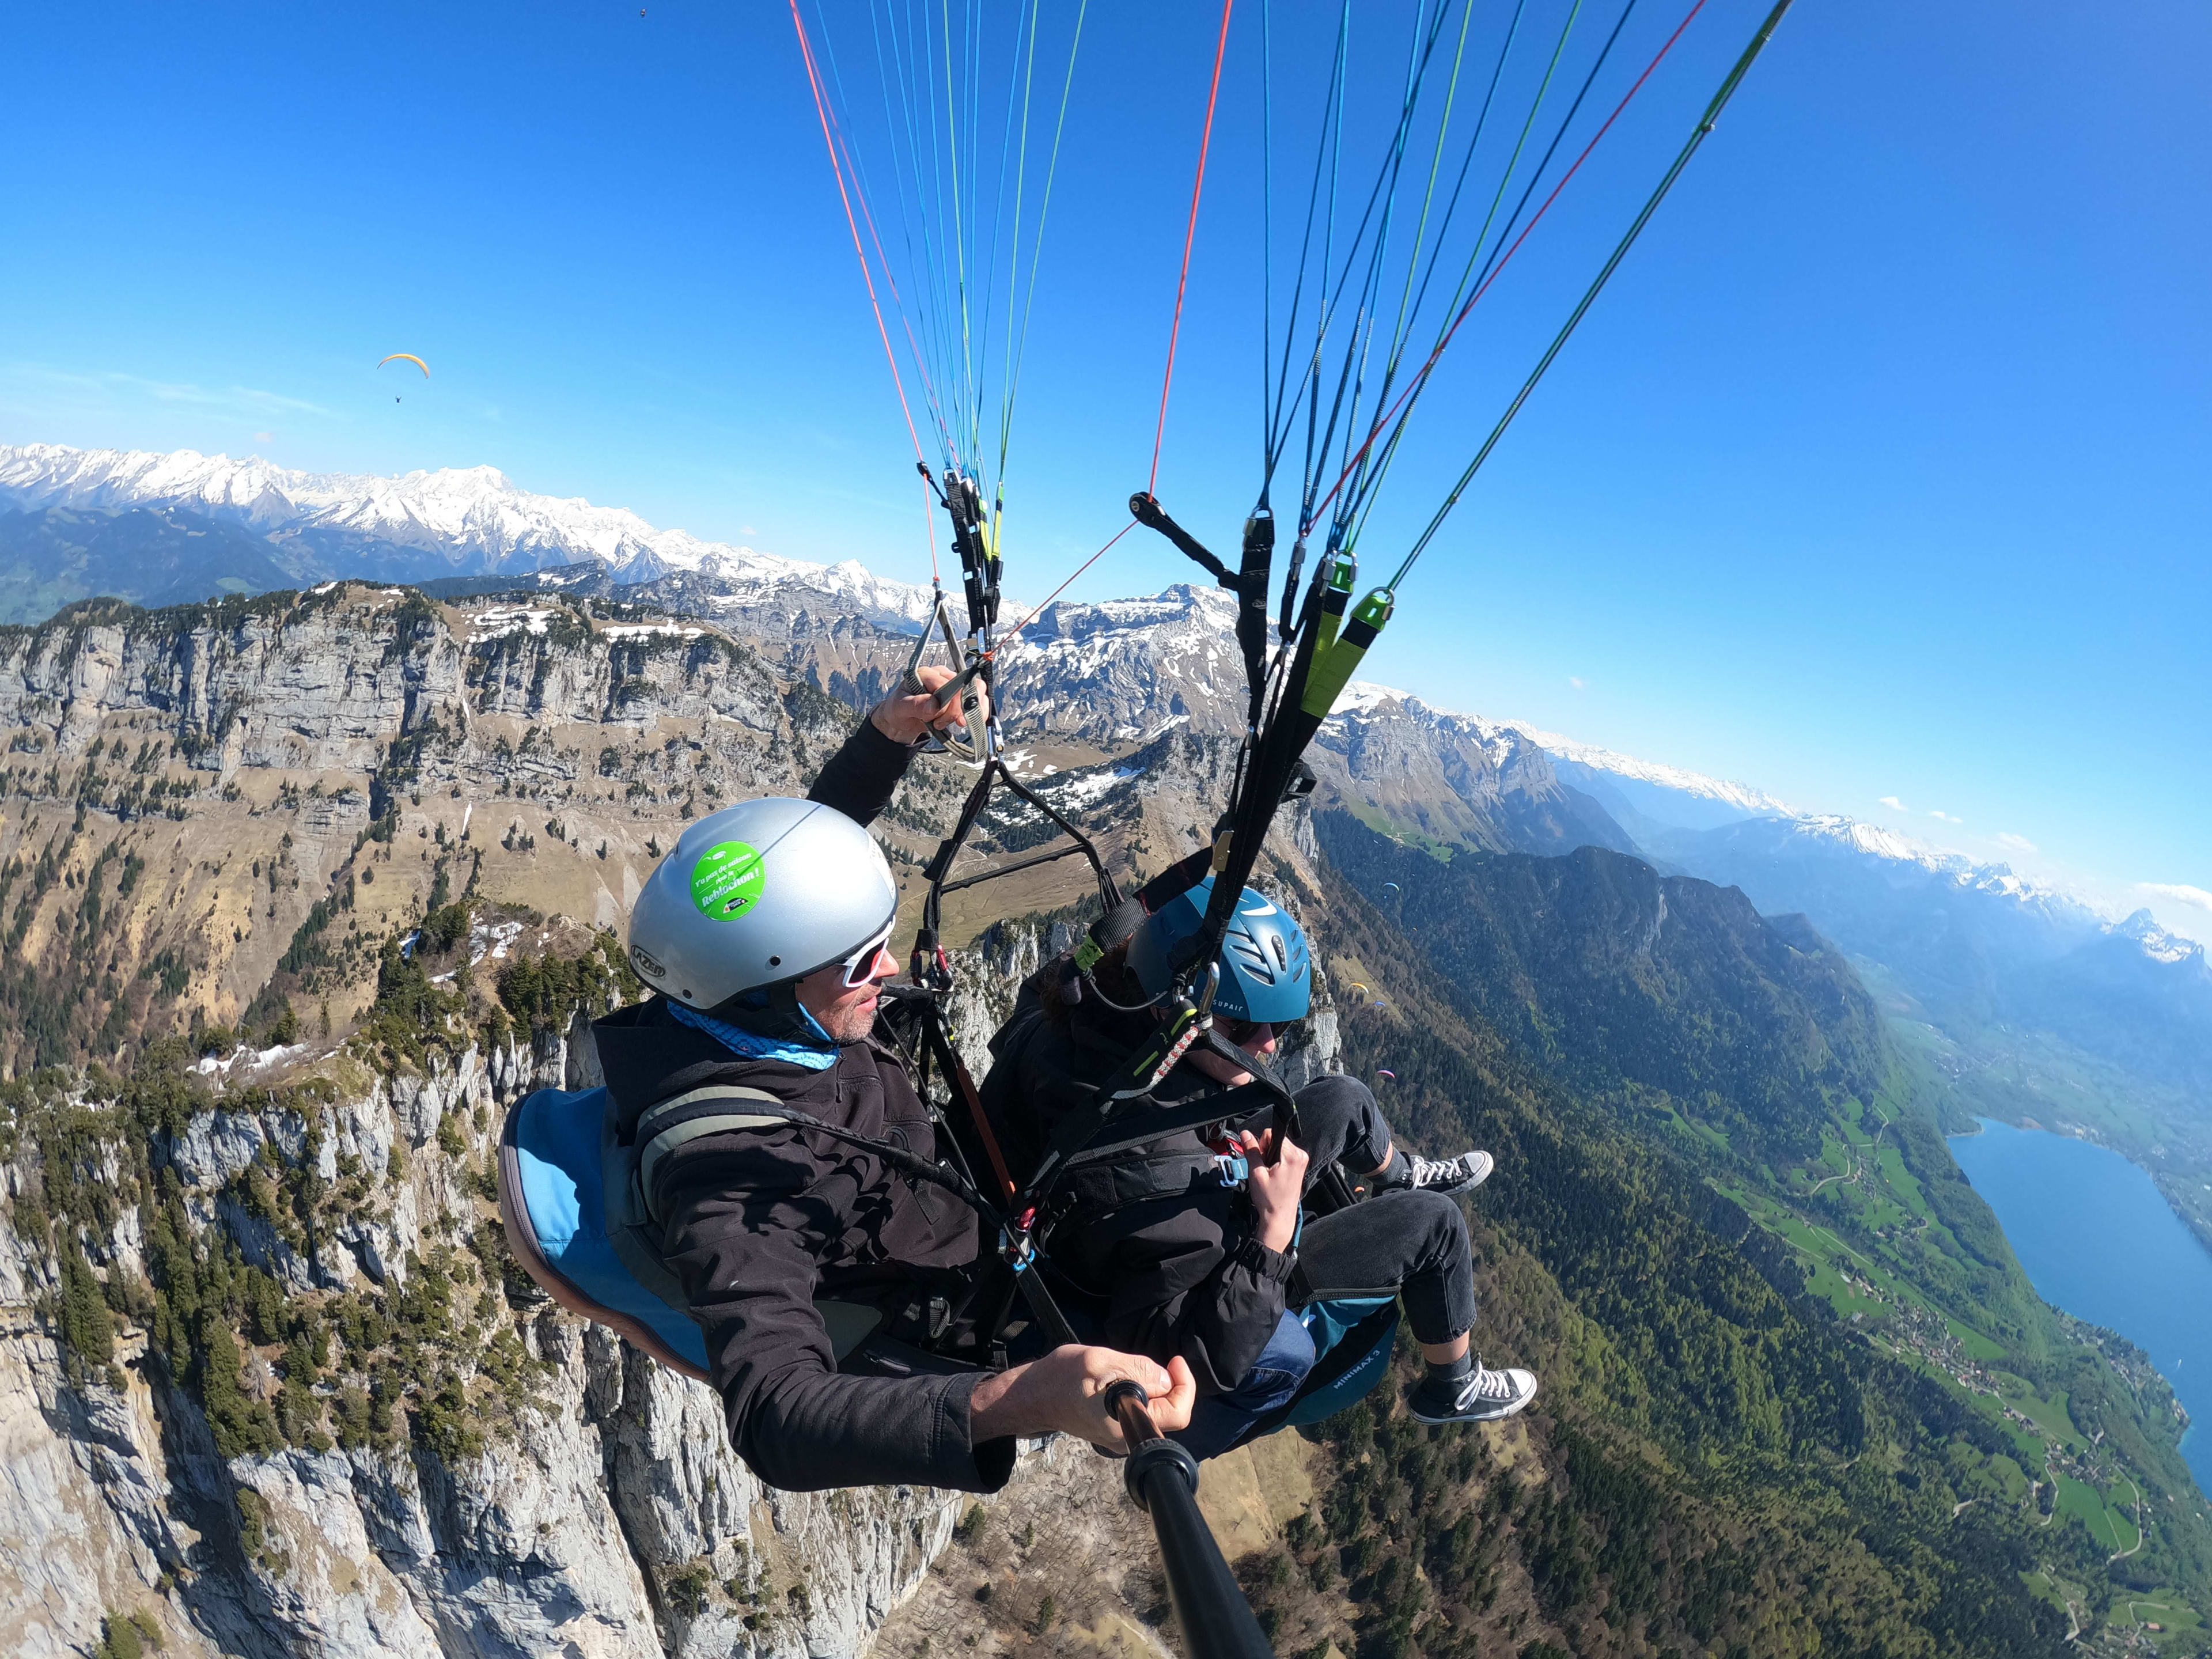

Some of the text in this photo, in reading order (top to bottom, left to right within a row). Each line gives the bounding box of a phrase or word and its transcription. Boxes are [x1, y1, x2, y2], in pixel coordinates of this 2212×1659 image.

[706, 870, 718, 882] pas
[718, 865, 728, 873] de
[728, 853, 752, 868] saison
[702, 870, 755, 907] Reblochon
[633, 946, 662, 976] LAZER
[1334, 1356, 1374, 1389] MINIMAX
